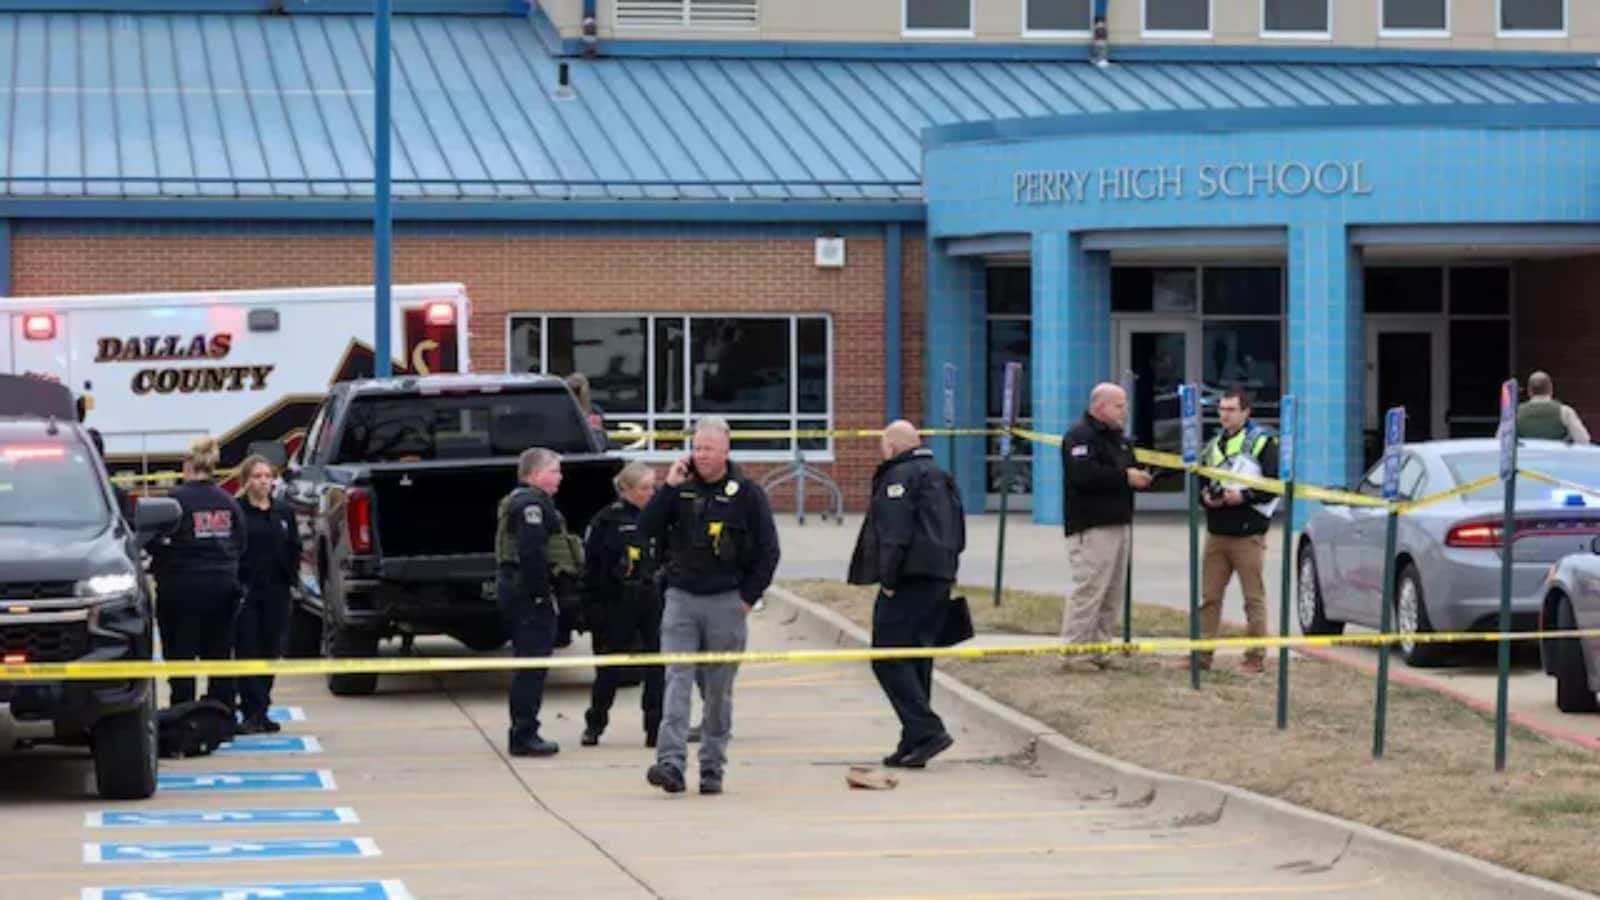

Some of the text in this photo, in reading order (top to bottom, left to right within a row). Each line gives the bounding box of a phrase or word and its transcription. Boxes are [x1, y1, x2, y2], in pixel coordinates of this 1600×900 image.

[1014, 160, 1372, 204] PERRY HIGH SCHOOL
[95, 333, 232, 363] DALLAS
[131, 365, 275, 395] COUNTY
